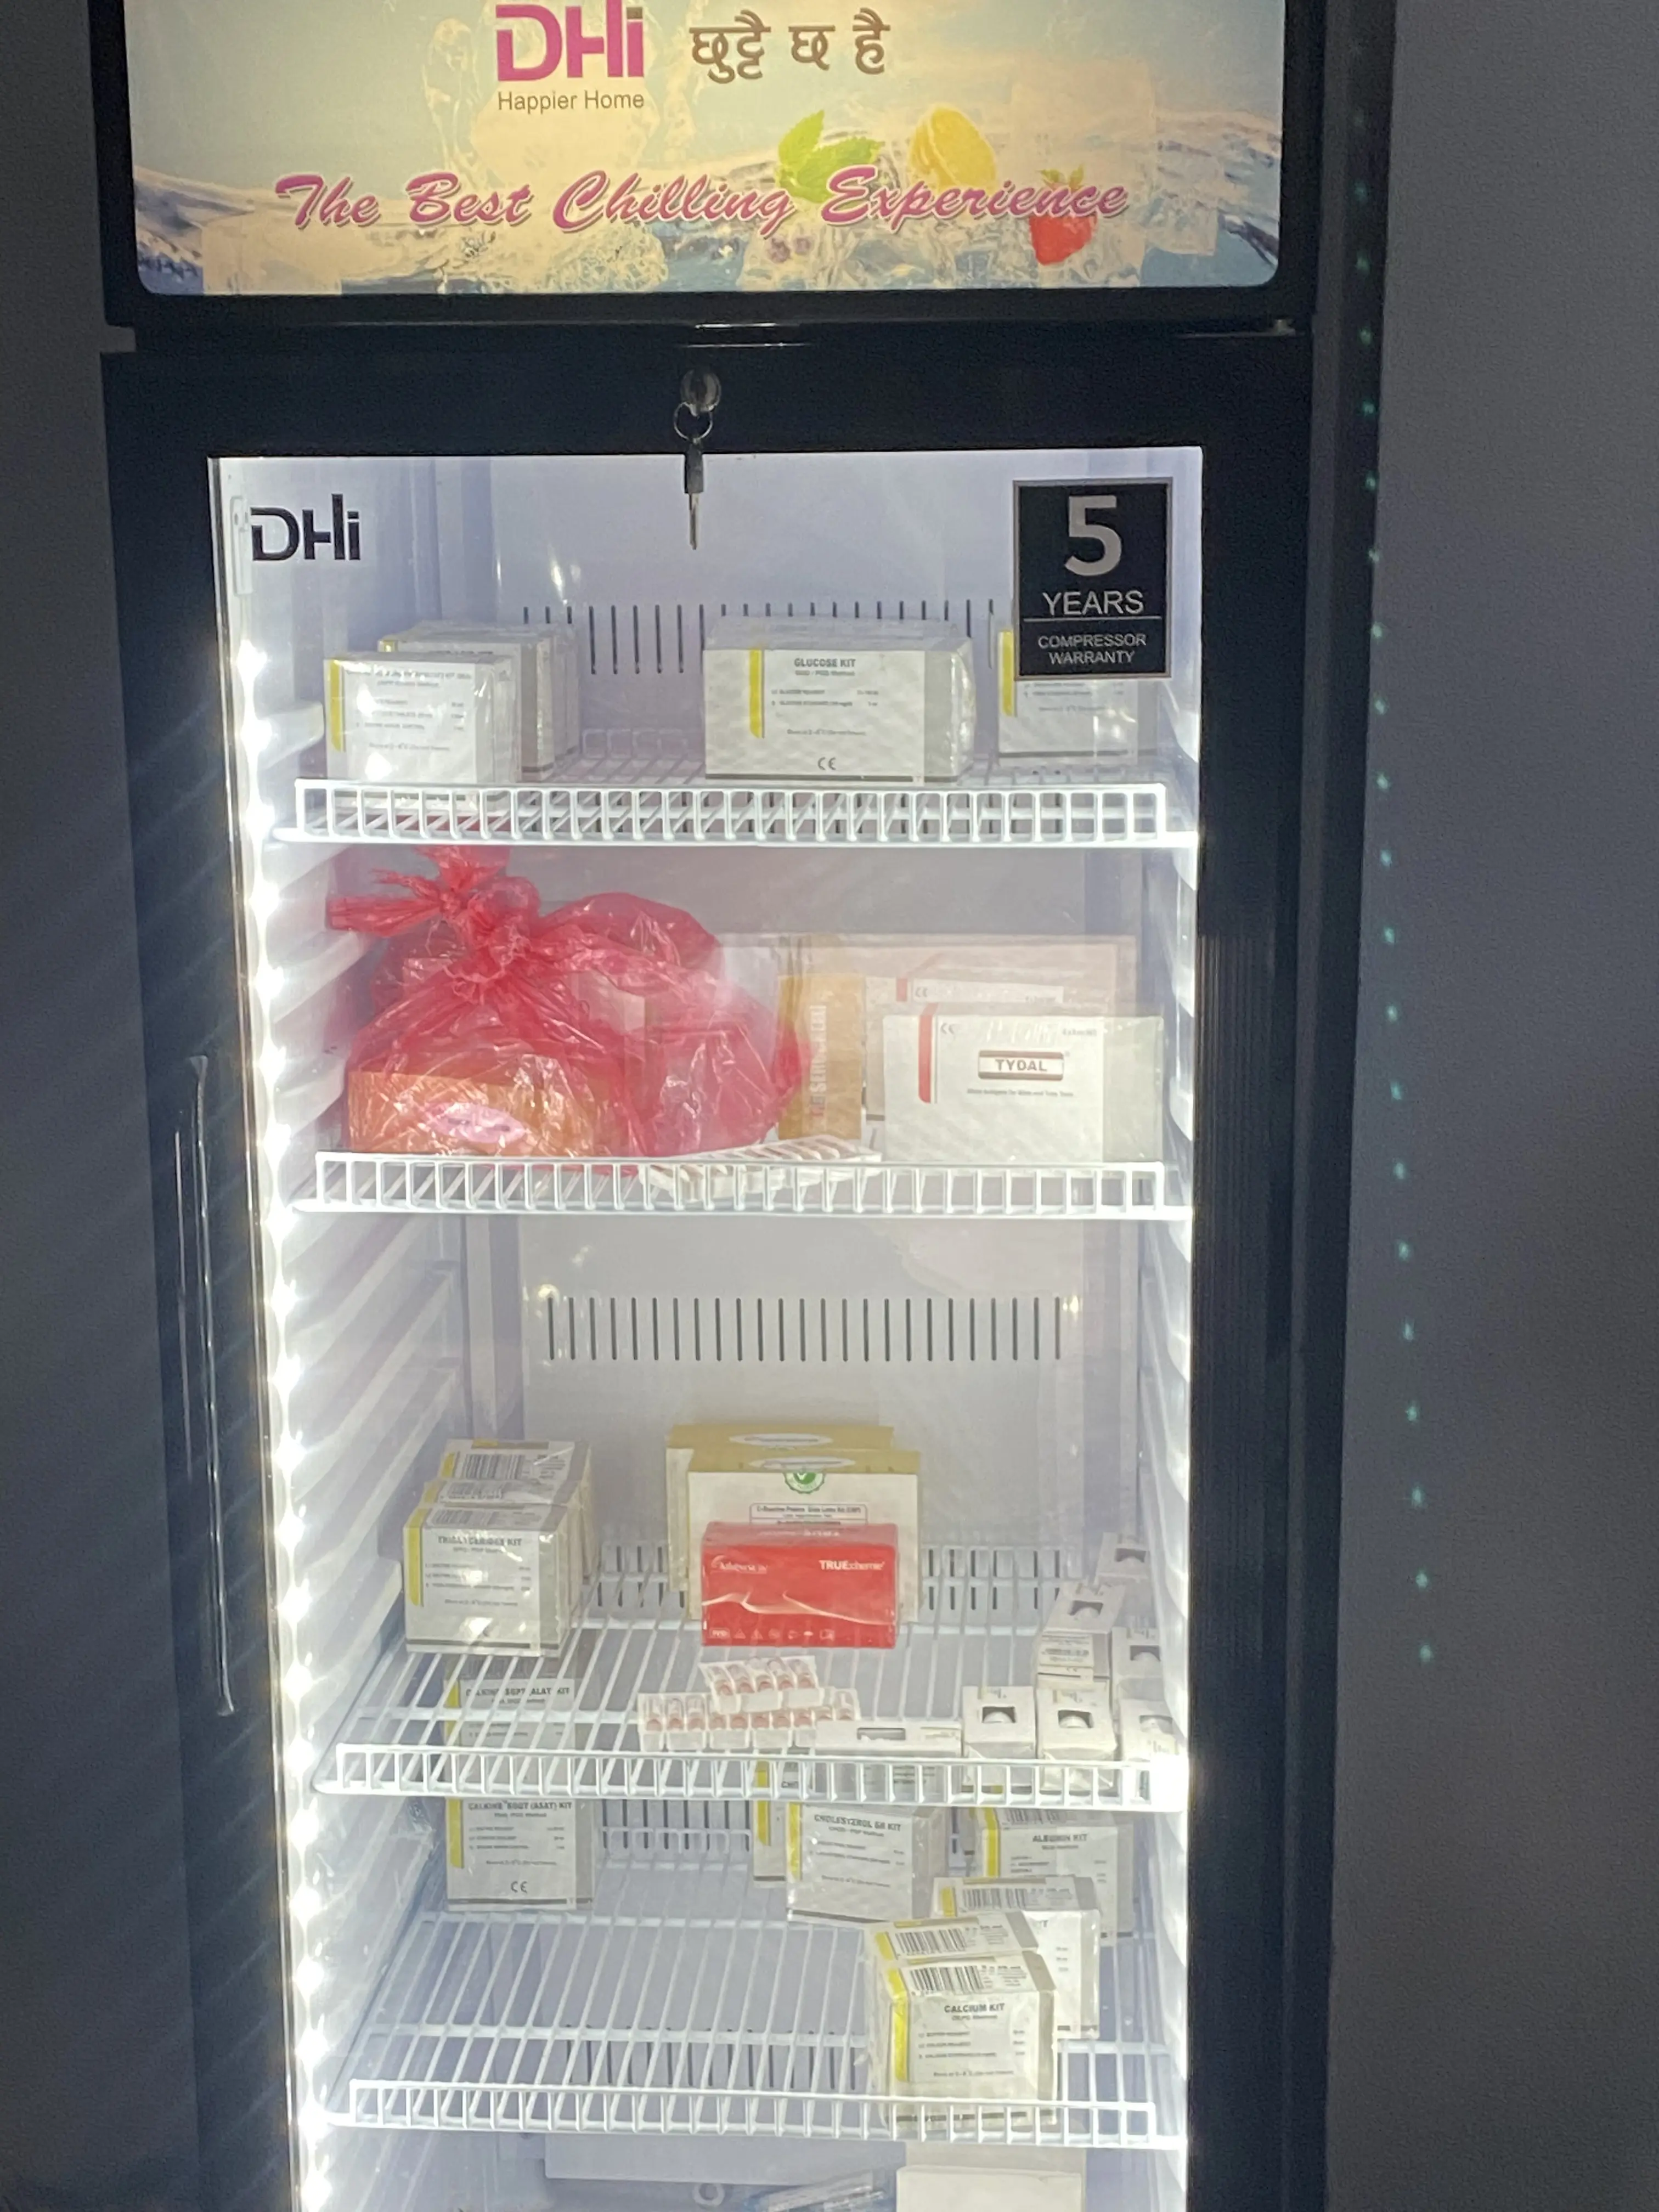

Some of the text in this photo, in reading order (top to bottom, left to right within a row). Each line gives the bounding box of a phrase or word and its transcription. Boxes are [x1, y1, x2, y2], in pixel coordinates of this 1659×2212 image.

[788, 25, 836, 71] छ
[852, 7, 891, 75] है
[498, 91, 644, 114] Happier Home
[275, 165, 1128, 238] The Best Chilling Experience
[1064, 495, 1122, 576] 5
[1042, 590, 1144, 616] YEARS
[1037, 633, 1147, 649] COMPRESSOR
[794, 658, 856, 668] GLUCOSE KIT
[1048, 650, 1135, 665] WARRANTY
[995, 1059, 1048, 1072] TYDAL
[944, 2002, 1005, 2013] CALCIUM KIT
